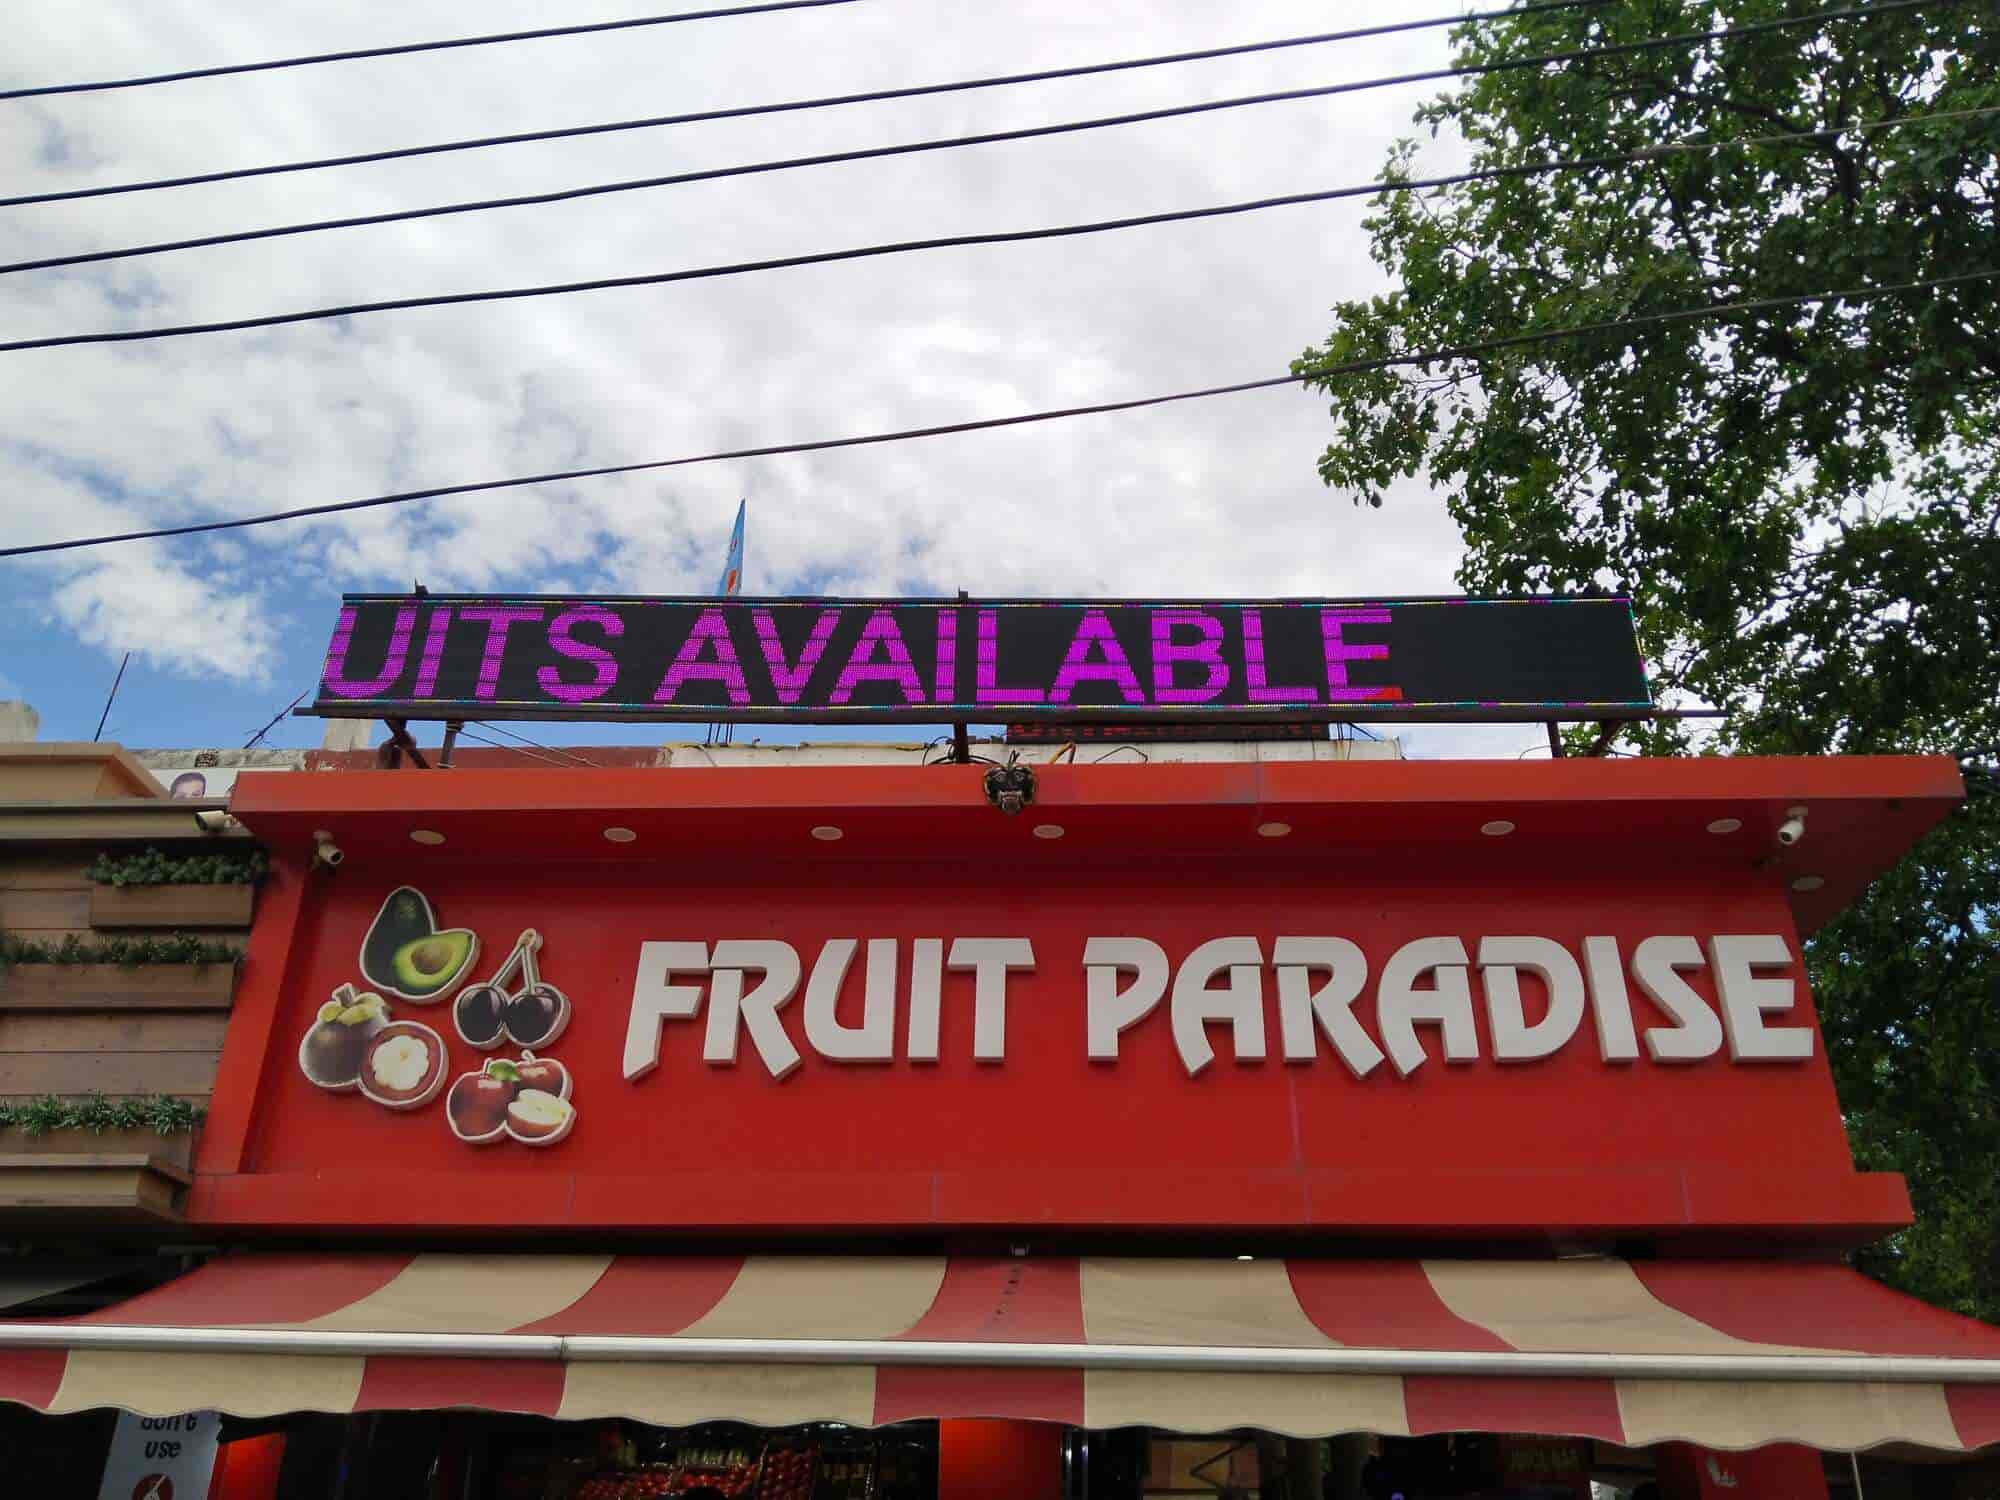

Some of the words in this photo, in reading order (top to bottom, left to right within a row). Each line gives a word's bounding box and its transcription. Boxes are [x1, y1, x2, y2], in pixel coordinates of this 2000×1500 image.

[323, 605, 624, 701] UITS
[653, 607, 1404, 704] AVAILABLE
[623, 937, 1036, 1081] FRUIT
[1083, 934, 1815, 1079] PARADISE
[144, 1440, 182, 1459] use
